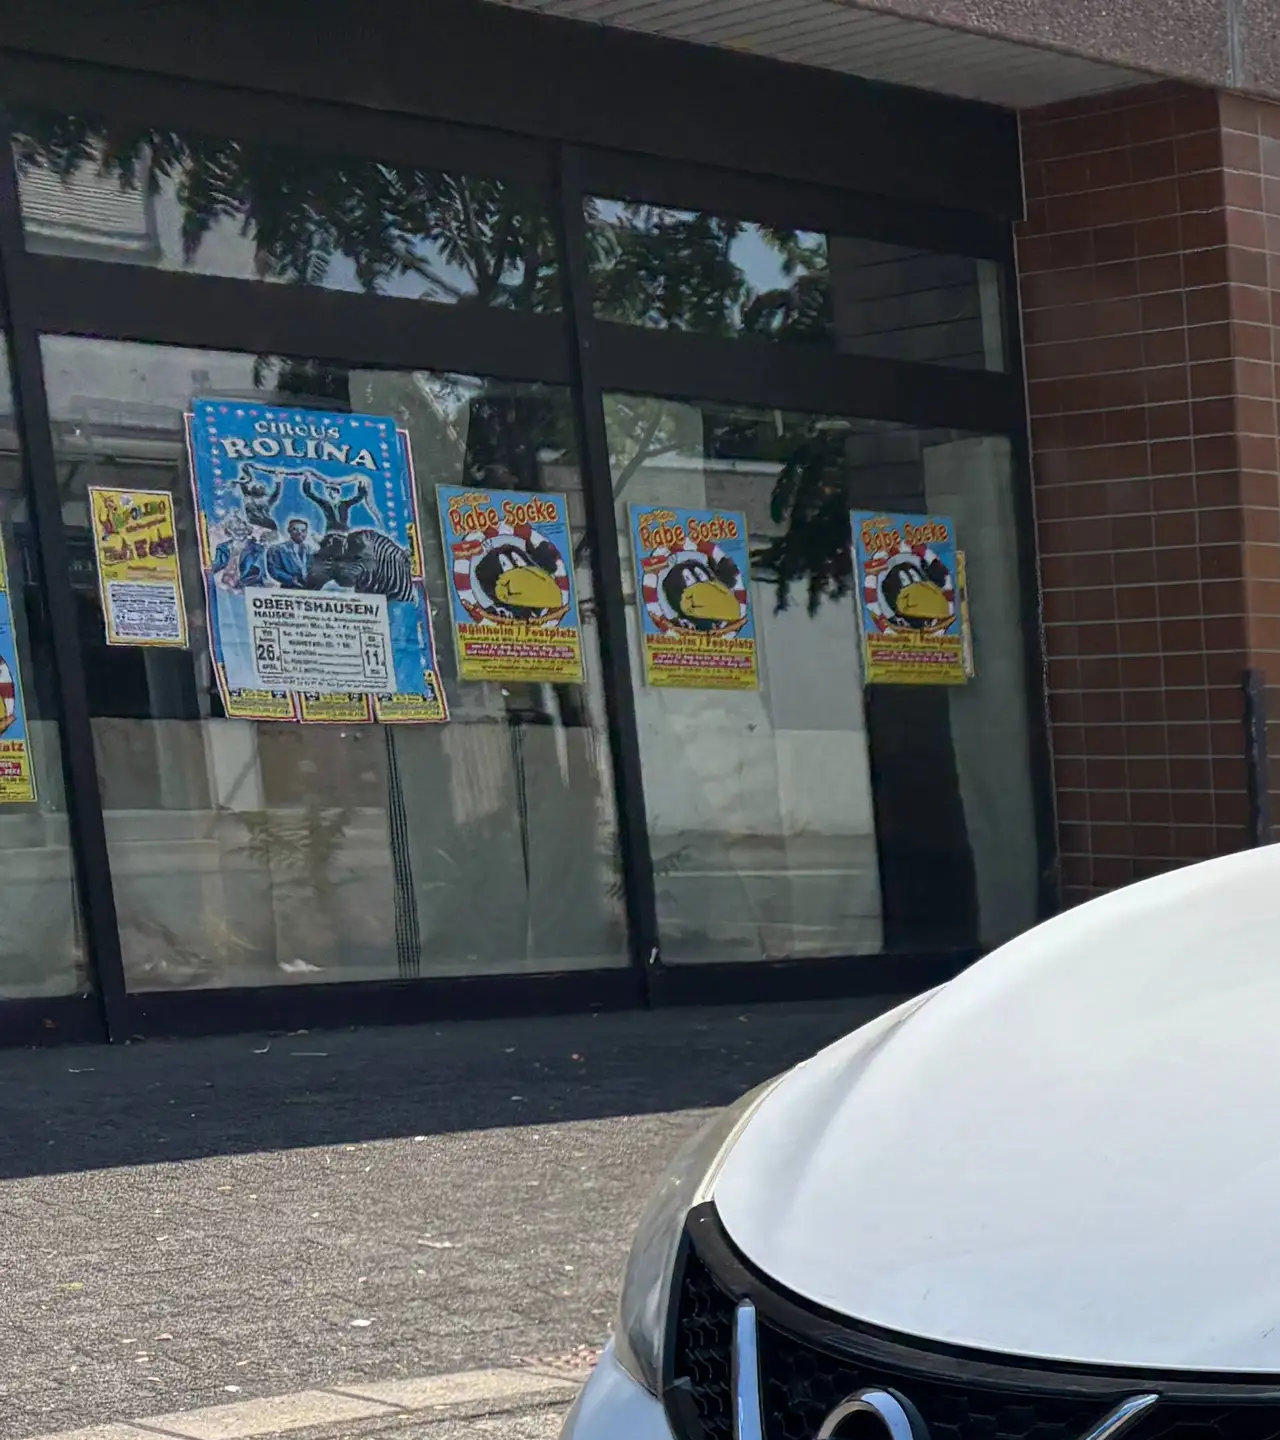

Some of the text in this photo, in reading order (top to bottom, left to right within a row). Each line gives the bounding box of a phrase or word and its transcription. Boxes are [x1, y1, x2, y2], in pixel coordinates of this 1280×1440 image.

[254, 420, 340, 439] CIRCUS
[221, 437, 378, 471] ROLINA
[448, 504, 499, 536] Rabe
[502, 496, 559, 525] Socke
[639, 521, 685, 552] Rabe
[687, 515, 739, 543] Socke
[252, 597, 380, 618] OBERTSHAUSEN/
[257, 644, 282, 661] 26.
